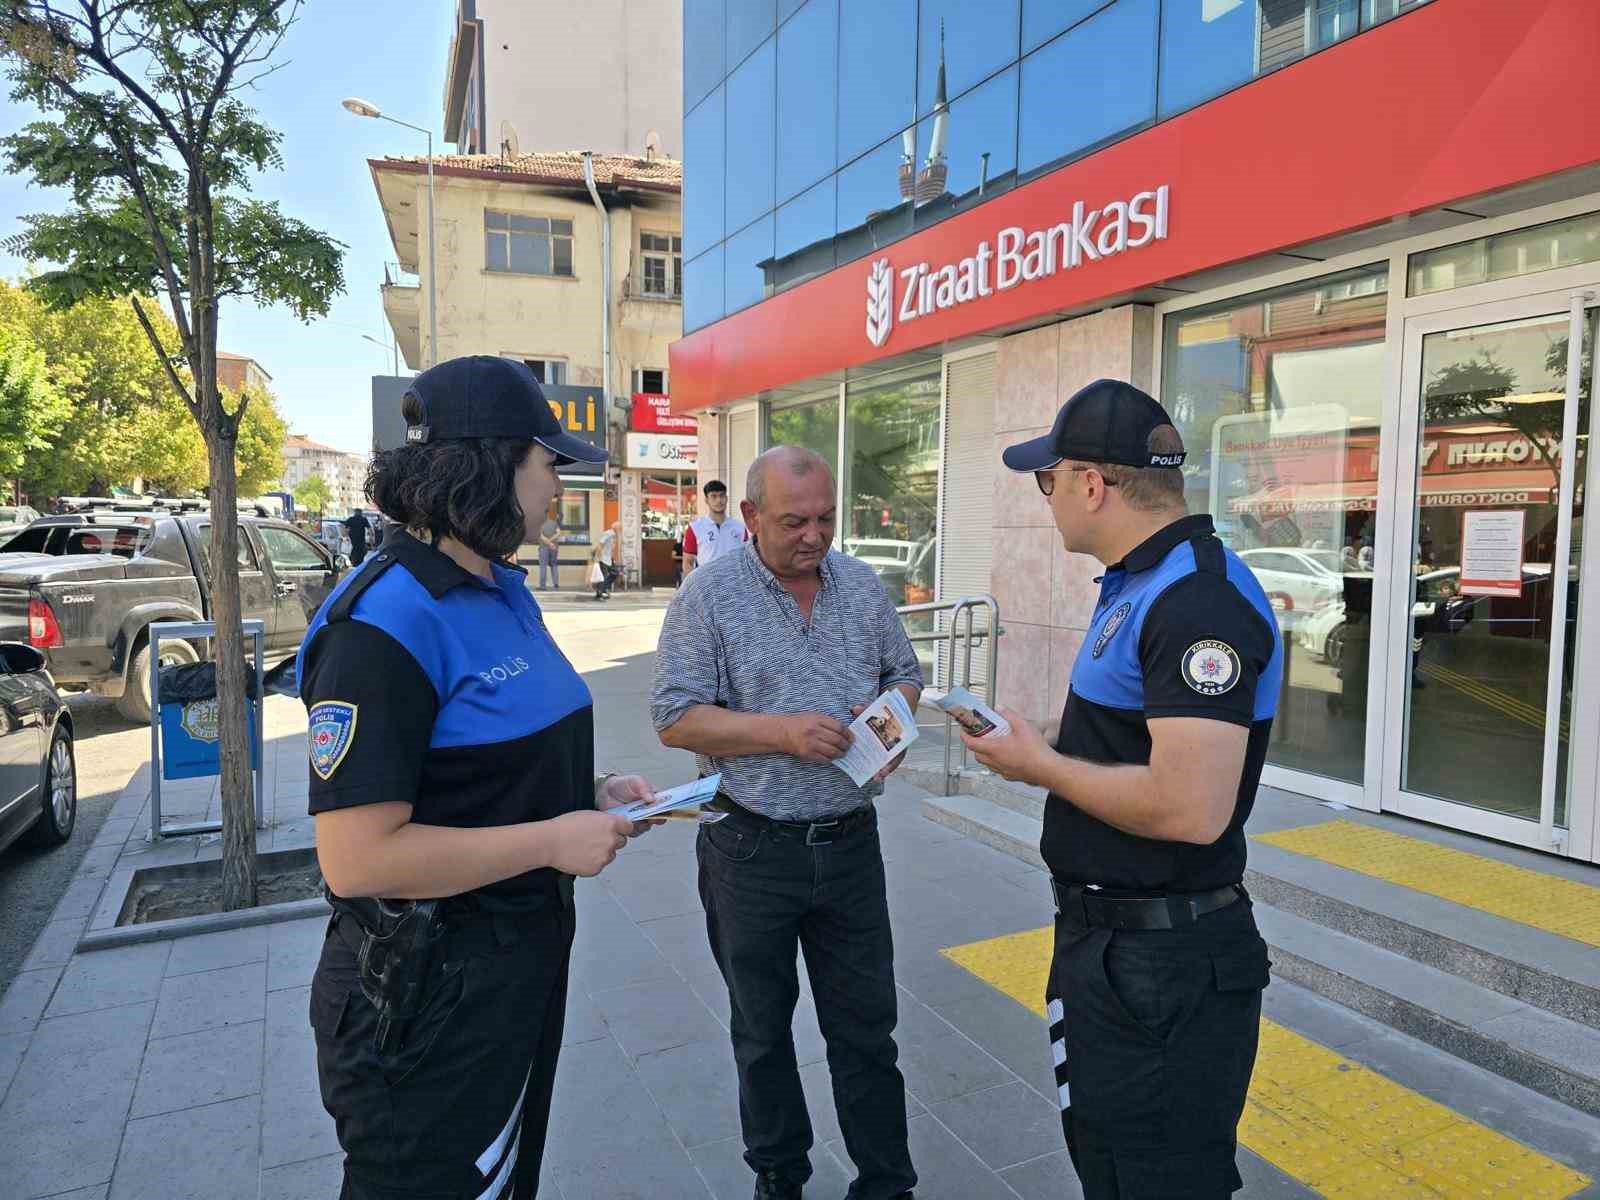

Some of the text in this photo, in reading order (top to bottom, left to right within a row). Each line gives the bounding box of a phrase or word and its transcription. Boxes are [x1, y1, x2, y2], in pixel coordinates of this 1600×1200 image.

[900, 185, 1169, 322] Ziraat Bankası
[706, 530, 716, 542] 2
